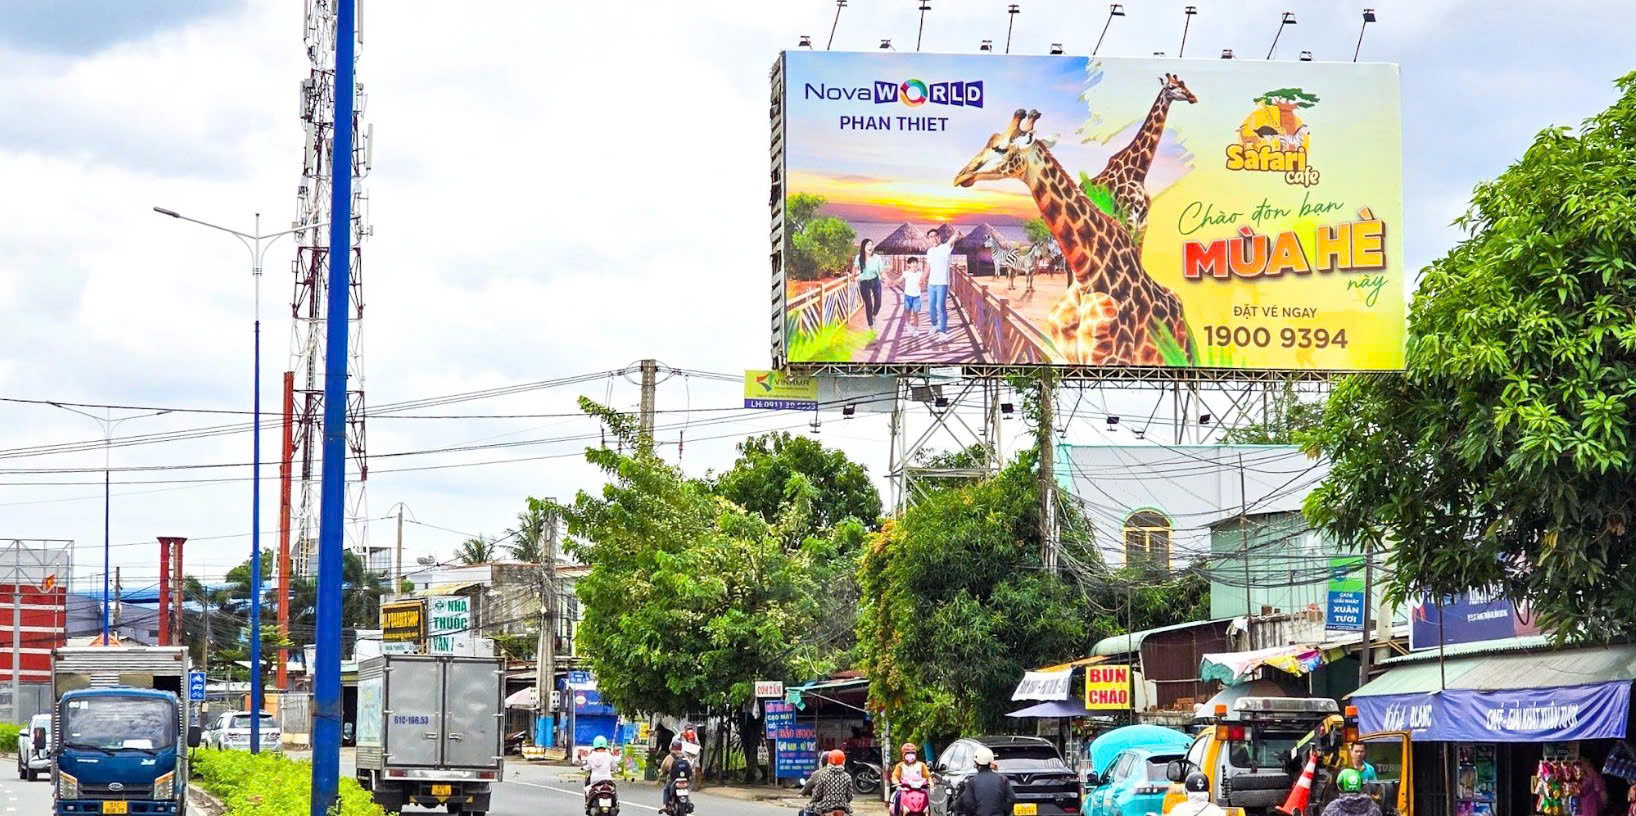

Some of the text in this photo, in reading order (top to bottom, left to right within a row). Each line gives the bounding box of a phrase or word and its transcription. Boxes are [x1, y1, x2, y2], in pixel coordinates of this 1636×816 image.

[840, 116, 949, 132] PHAN THIET
[1226, 144, 1307, 172] Safari
[1285, 165, 1320, 188] cafe
[1178, 191, 1345, 236] Chào đón bạn
[1184, 207, 1387, 283] MÙA HÈ
[1346, 274, 1389, 307] này
[1233, 303, 1318, 319] ĐẶT VÉ NGAY
[1203, 325, 1349, 349] 1900 9394
[1333, 605, 1360, 614] XUÂN
[1334, 614, 1357, 623] TƯƠI
[1383, 701, 1433, 731] 1664 BLANC
